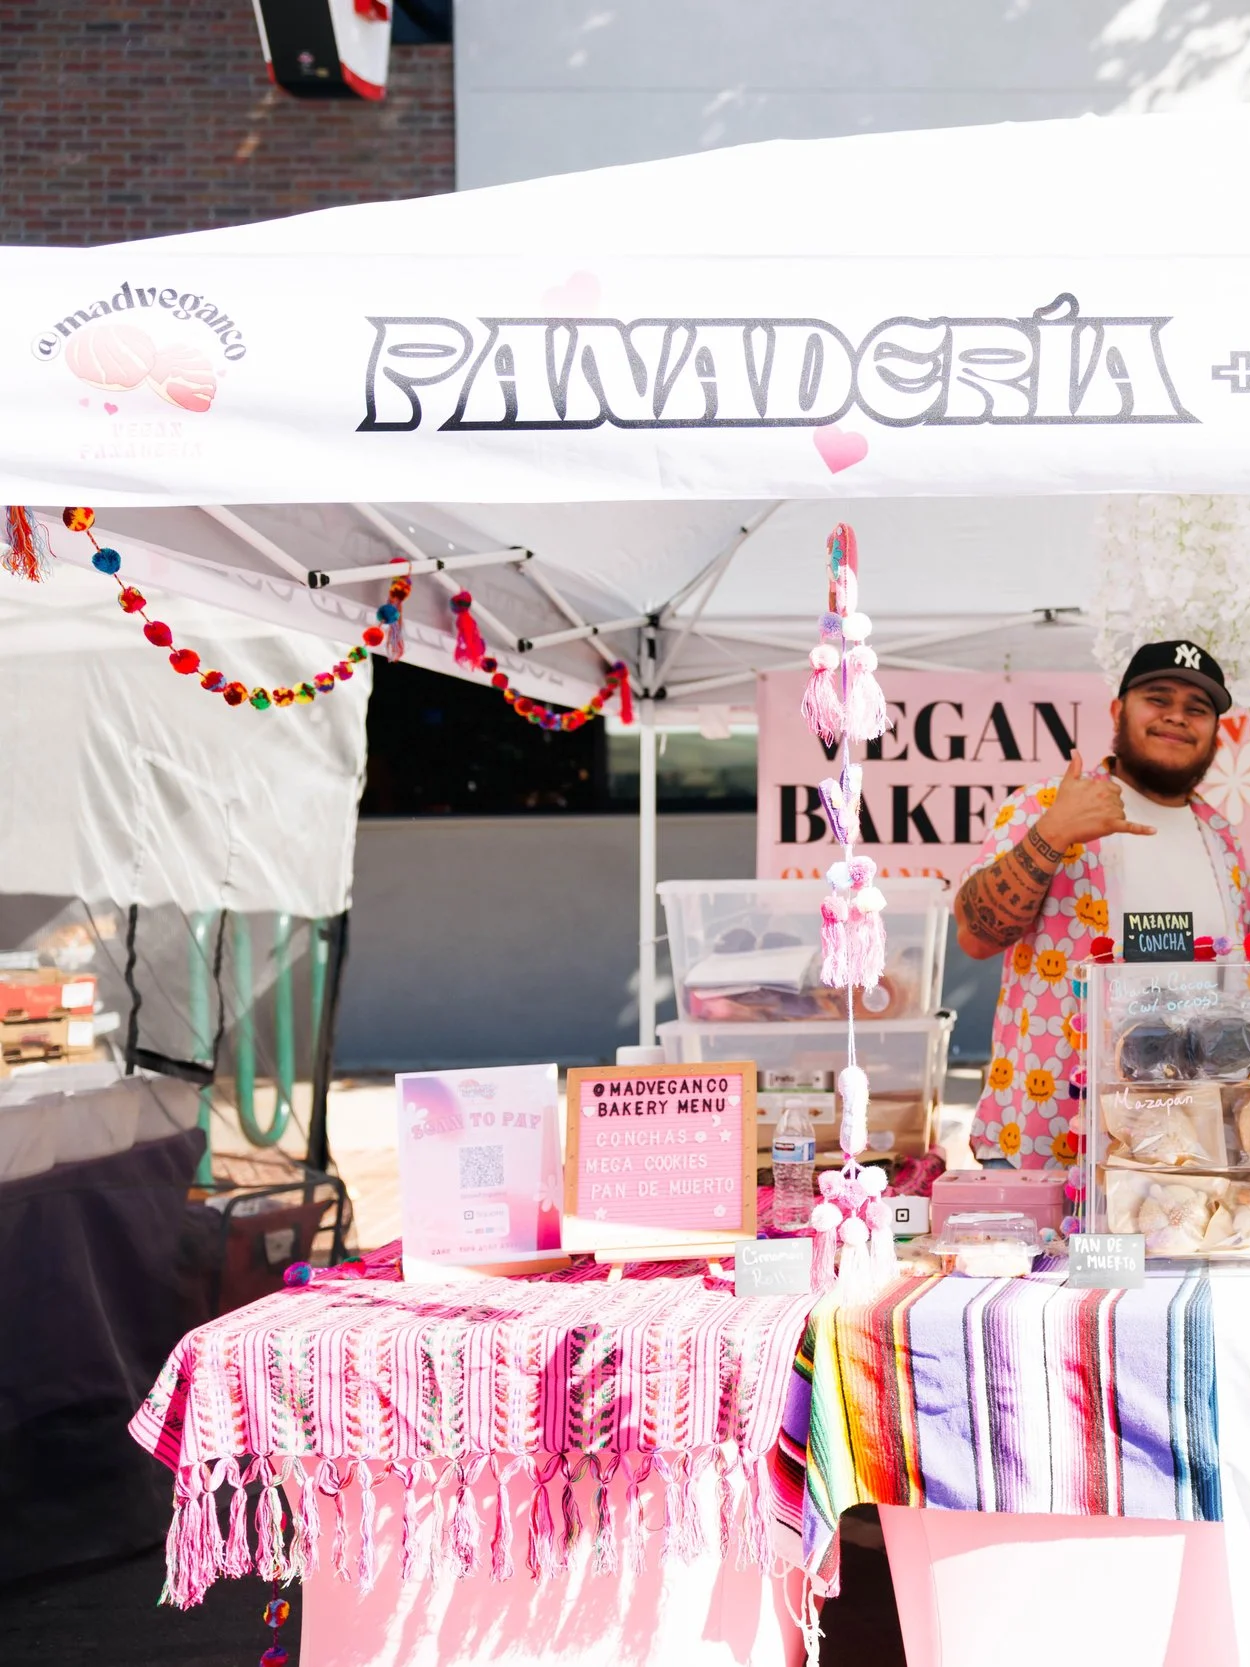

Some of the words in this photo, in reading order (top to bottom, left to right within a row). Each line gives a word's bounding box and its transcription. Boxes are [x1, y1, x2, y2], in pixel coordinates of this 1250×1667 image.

[31, 281, 247, 361] @madveganco
[356, 292, 1202, 432] PANADERÍA
[774, 784, 1025, 845] BAKE
[1129, 914, 1189, 931] MAZAPAN
[1138, 932, 1186, 952] CONCHA
[598, 1100, 668, 1117] BAKERY
[678, 1098, 725, 1114] MENU
[1114, 1089, 1193, 1116] Mazapan
[469, 1111, 495, 1128] TO
[502, 1111, 541, 1130] PAY
[596, 1129, 687, 1147] CONCHAS
[585, 1156, 632, 1174] MEGA
[644, 1153, 708, 1172] COOKIES
[591, 1182, 626, 1200] PAN
[638, 1180, 659, 1197] DE
[669, 1177, 734, 1196] MUERTO
[1074, 1237, 1100, 1254] PAN
[1107, 1237, 1123, 1253] DE
